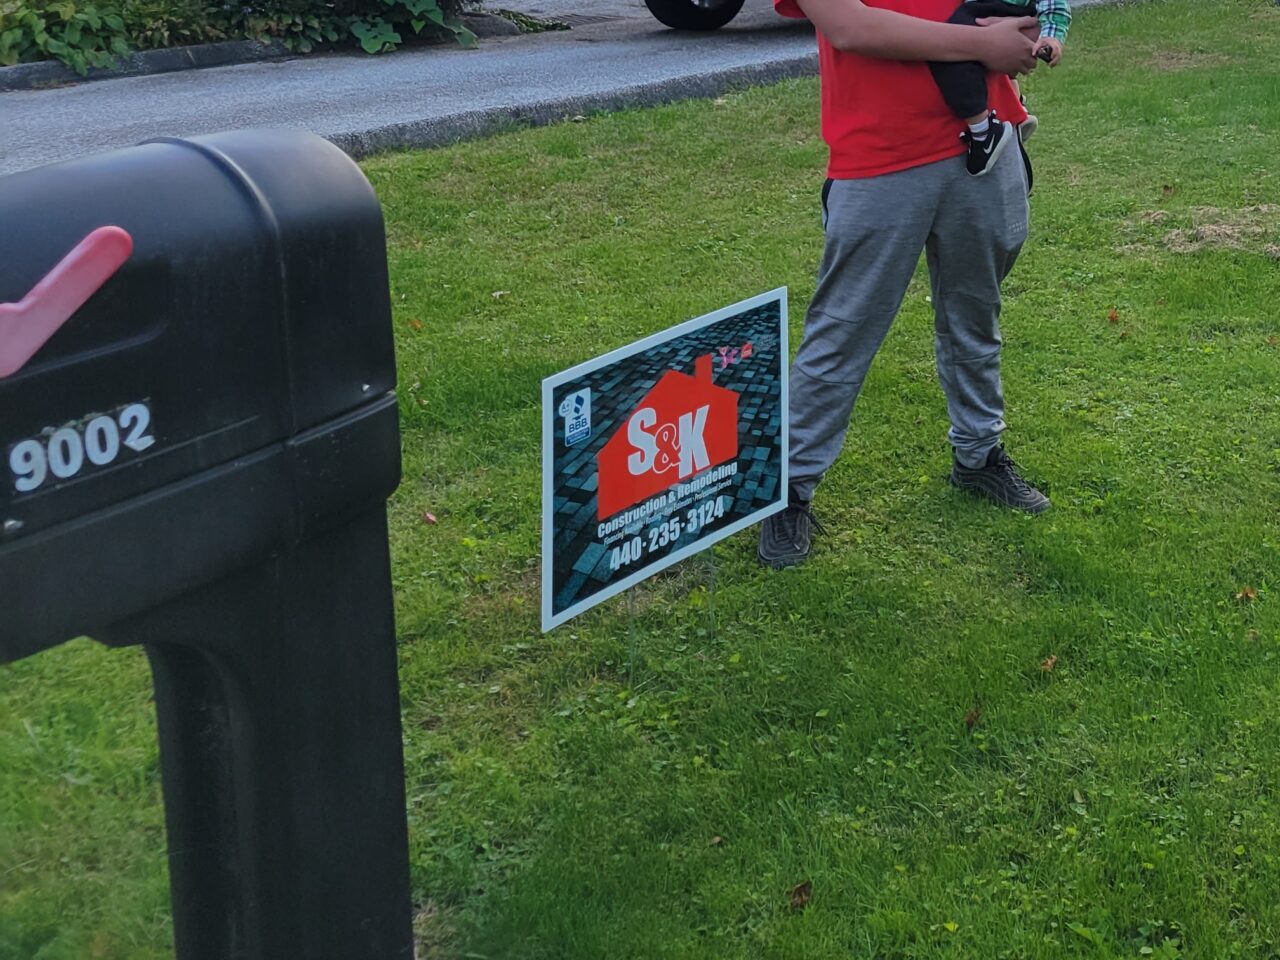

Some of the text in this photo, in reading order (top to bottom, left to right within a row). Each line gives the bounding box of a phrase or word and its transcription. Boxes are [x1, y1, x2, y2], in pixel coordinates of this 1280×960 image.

[10, 403, 156, 492] 9002
[569, 417, 588, 433] BBB
[627, 404, 711, 480] S&K
[597, 461, 738, 539] Construction & Remodeling
